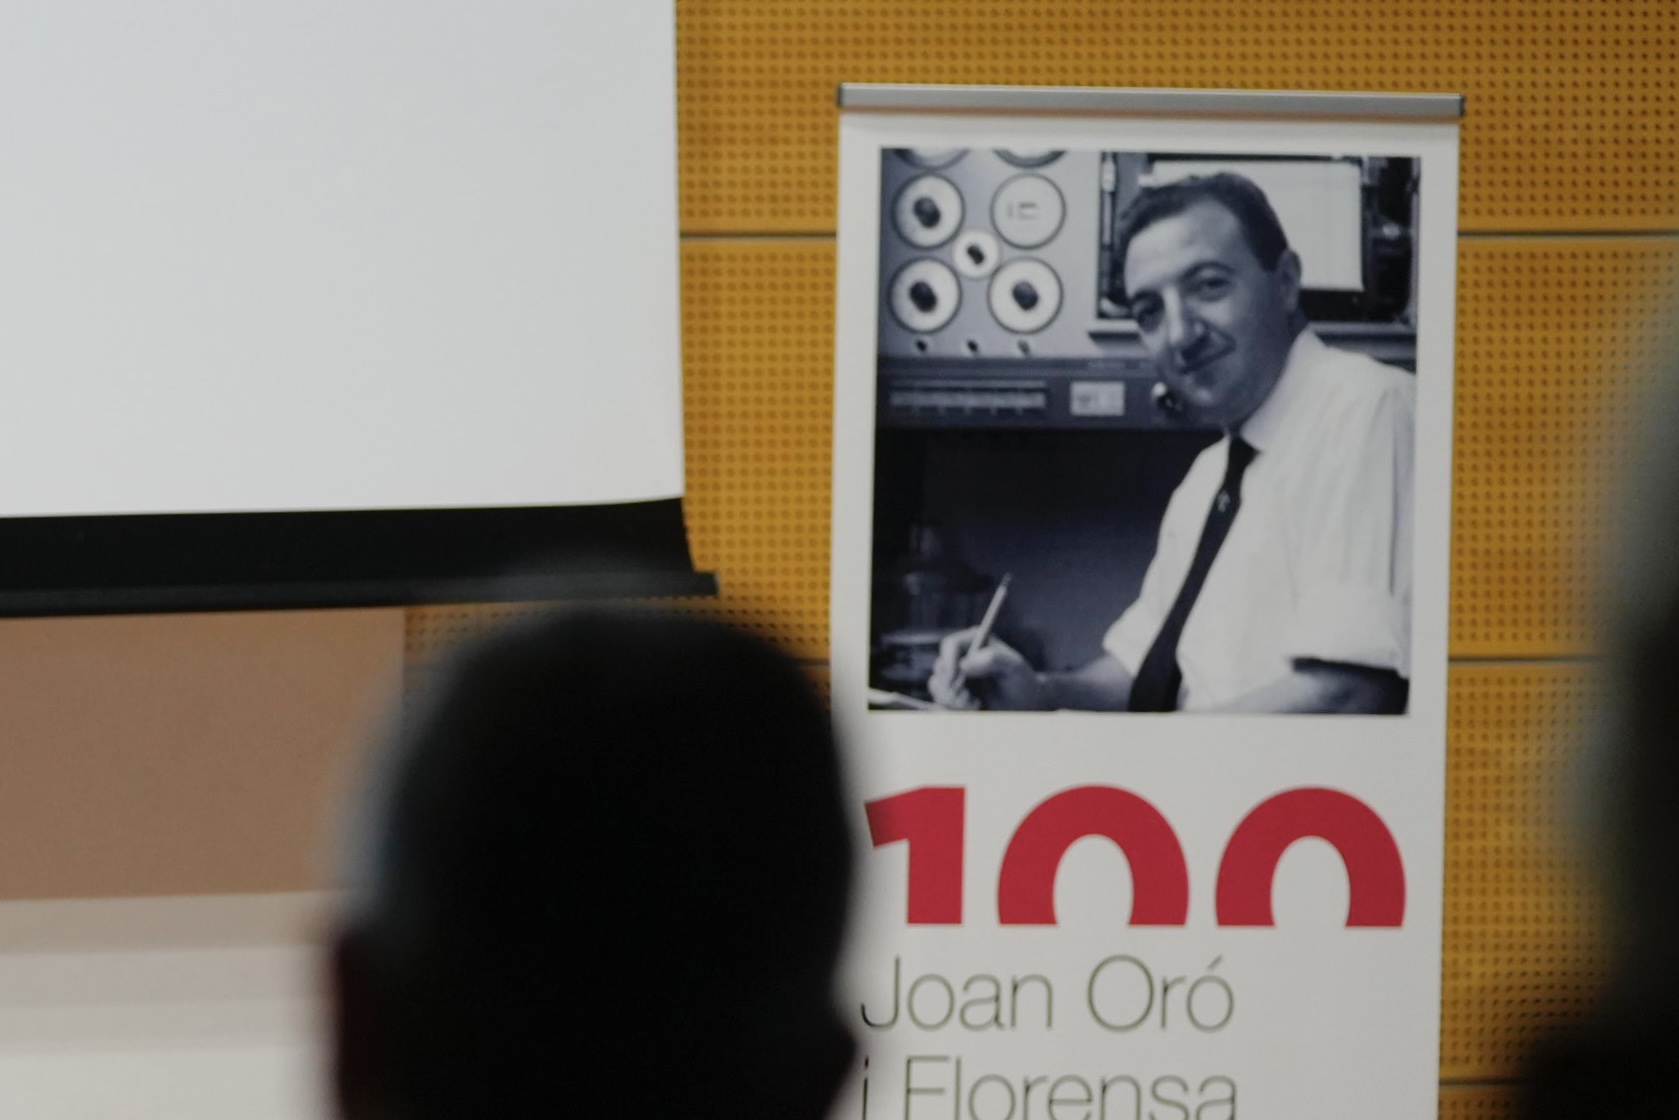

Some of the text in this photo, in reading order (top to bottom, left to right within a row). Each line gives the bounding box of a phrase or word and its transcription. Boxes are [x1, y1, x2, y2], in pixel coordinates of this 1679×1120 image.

[864, 785, 1406, 928] 100
[860, 954, 1235, 1033] Joan Oró
